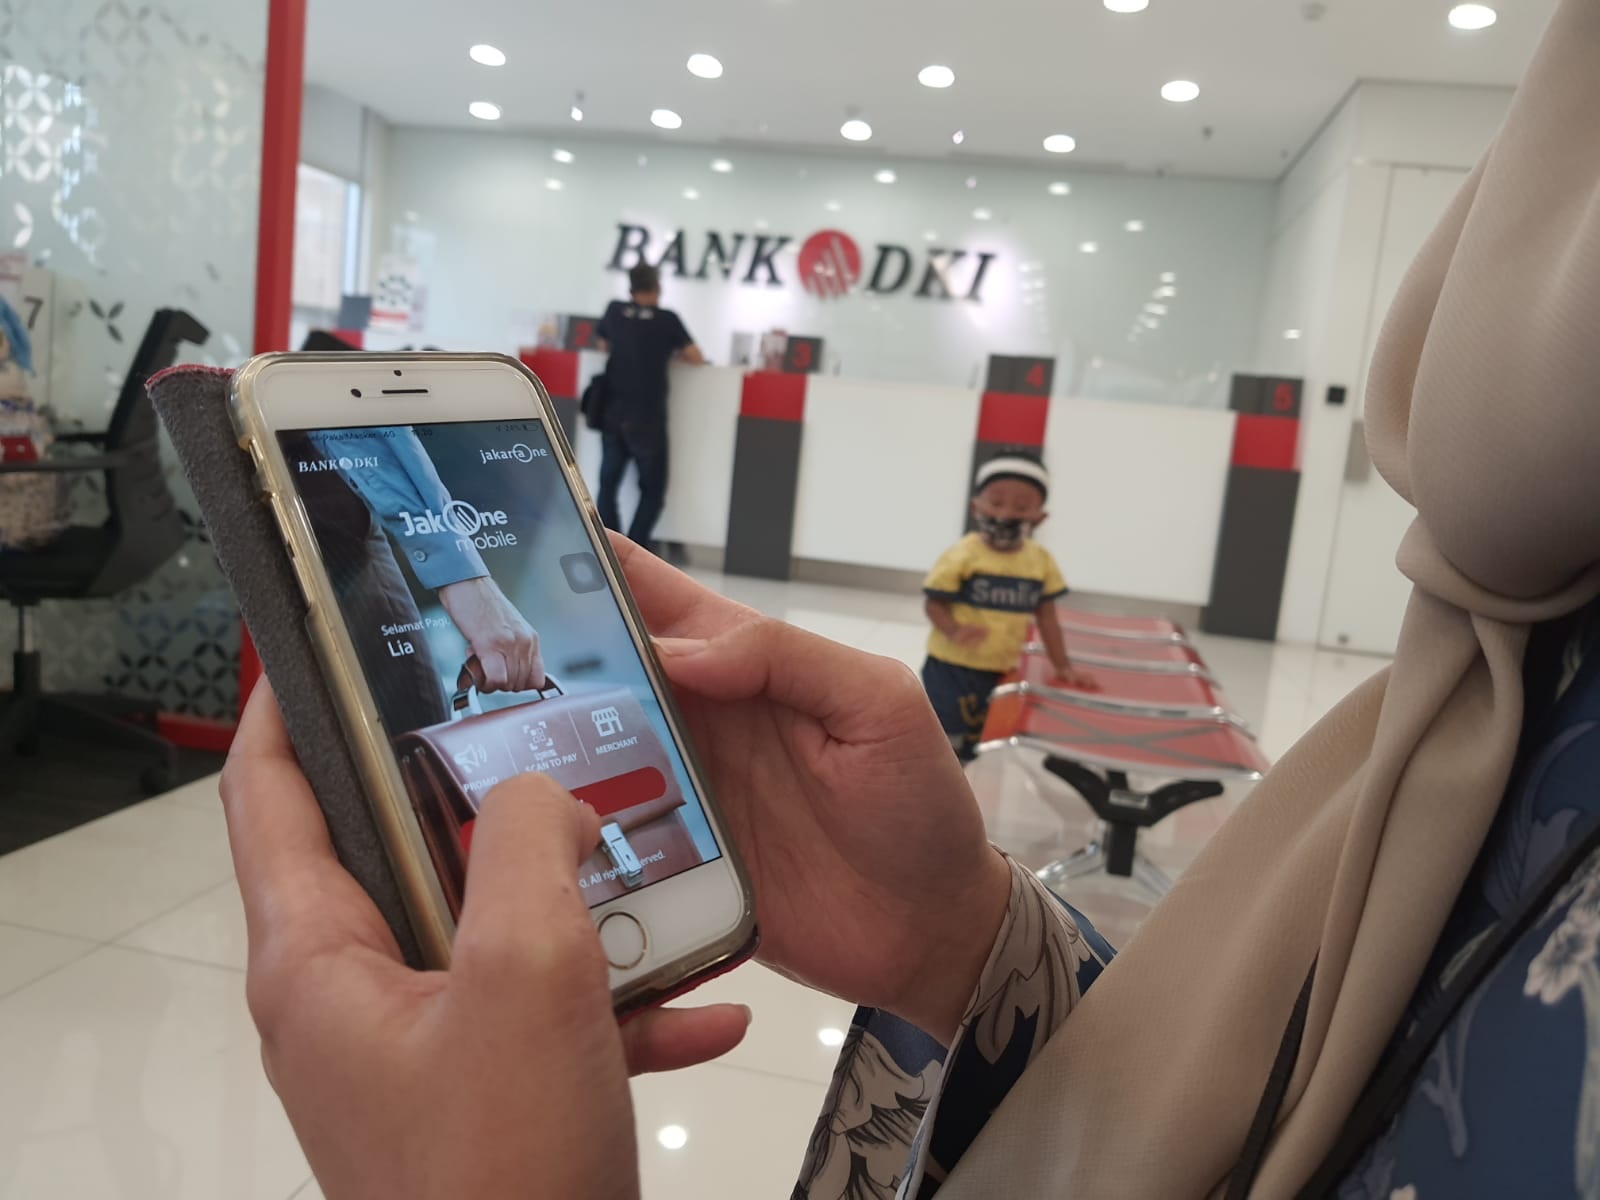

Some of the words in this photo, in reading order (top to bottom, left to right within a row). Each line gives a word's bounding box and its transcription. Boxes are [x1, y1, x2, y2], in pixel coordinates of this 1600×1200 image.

[607, 223, 791, 286] BANK
[864, 244, 997, 303] DKI
[575, 321, 592, 347] 2
[793, 342, 812, 369] 3
[1025, 364, 1046, 389] 4
[298, 460, 339, 473] BANK
[354, 456, 379, 469] DKI
[456, 530, 518, 552] mobile
[381, 620, 425, 637] Selamat
[387, 638, 414, 658] Lia
[595, 736, 639, 756] MERCHANT
[525, 761, 550, 773] SCAN
[549, 757, 562, 769] TO
[562, 752, 578, 766] PAY
[463, 775, 499, 794] PROMO
